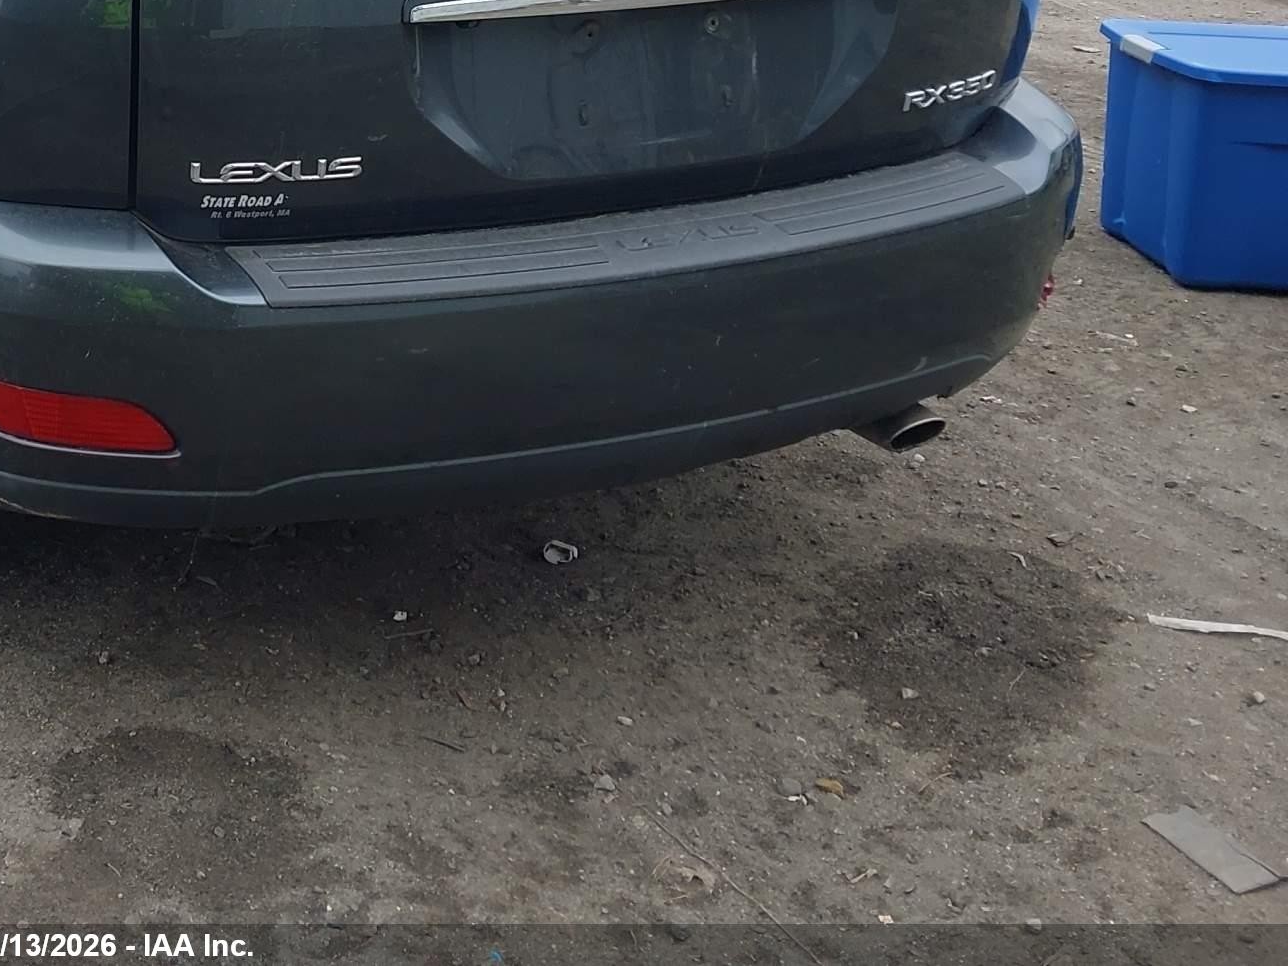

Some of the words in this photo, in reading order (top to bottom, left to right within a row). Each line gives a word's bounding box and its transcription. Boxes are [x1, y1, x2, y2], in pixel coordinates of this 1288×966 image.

[190, 156, 362, 183] LEXUS
[201, 195, 237, 208] STATE
[238, 195, 273, 207] ROAD
